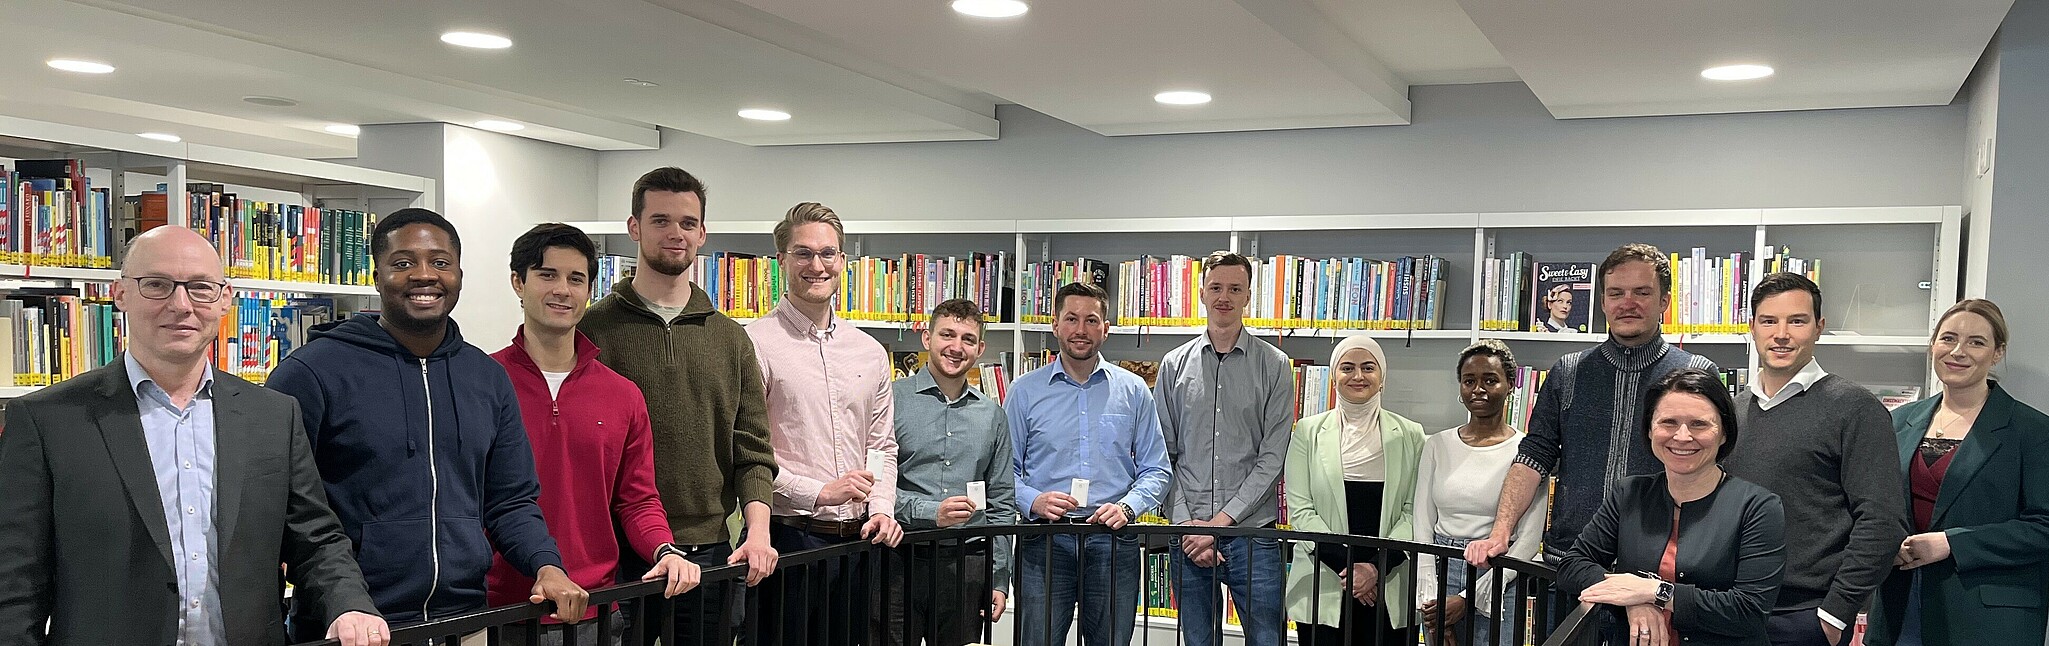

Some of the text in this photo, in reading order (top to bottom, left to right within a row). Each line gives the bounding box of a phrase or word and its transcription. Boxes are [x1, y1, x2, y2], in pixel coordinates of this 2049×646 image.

[1539, 266, 1564, 281] Sweet
[1570, 265, 1589, 279] Easy
[1351, 283, 1359, 305] LEON
